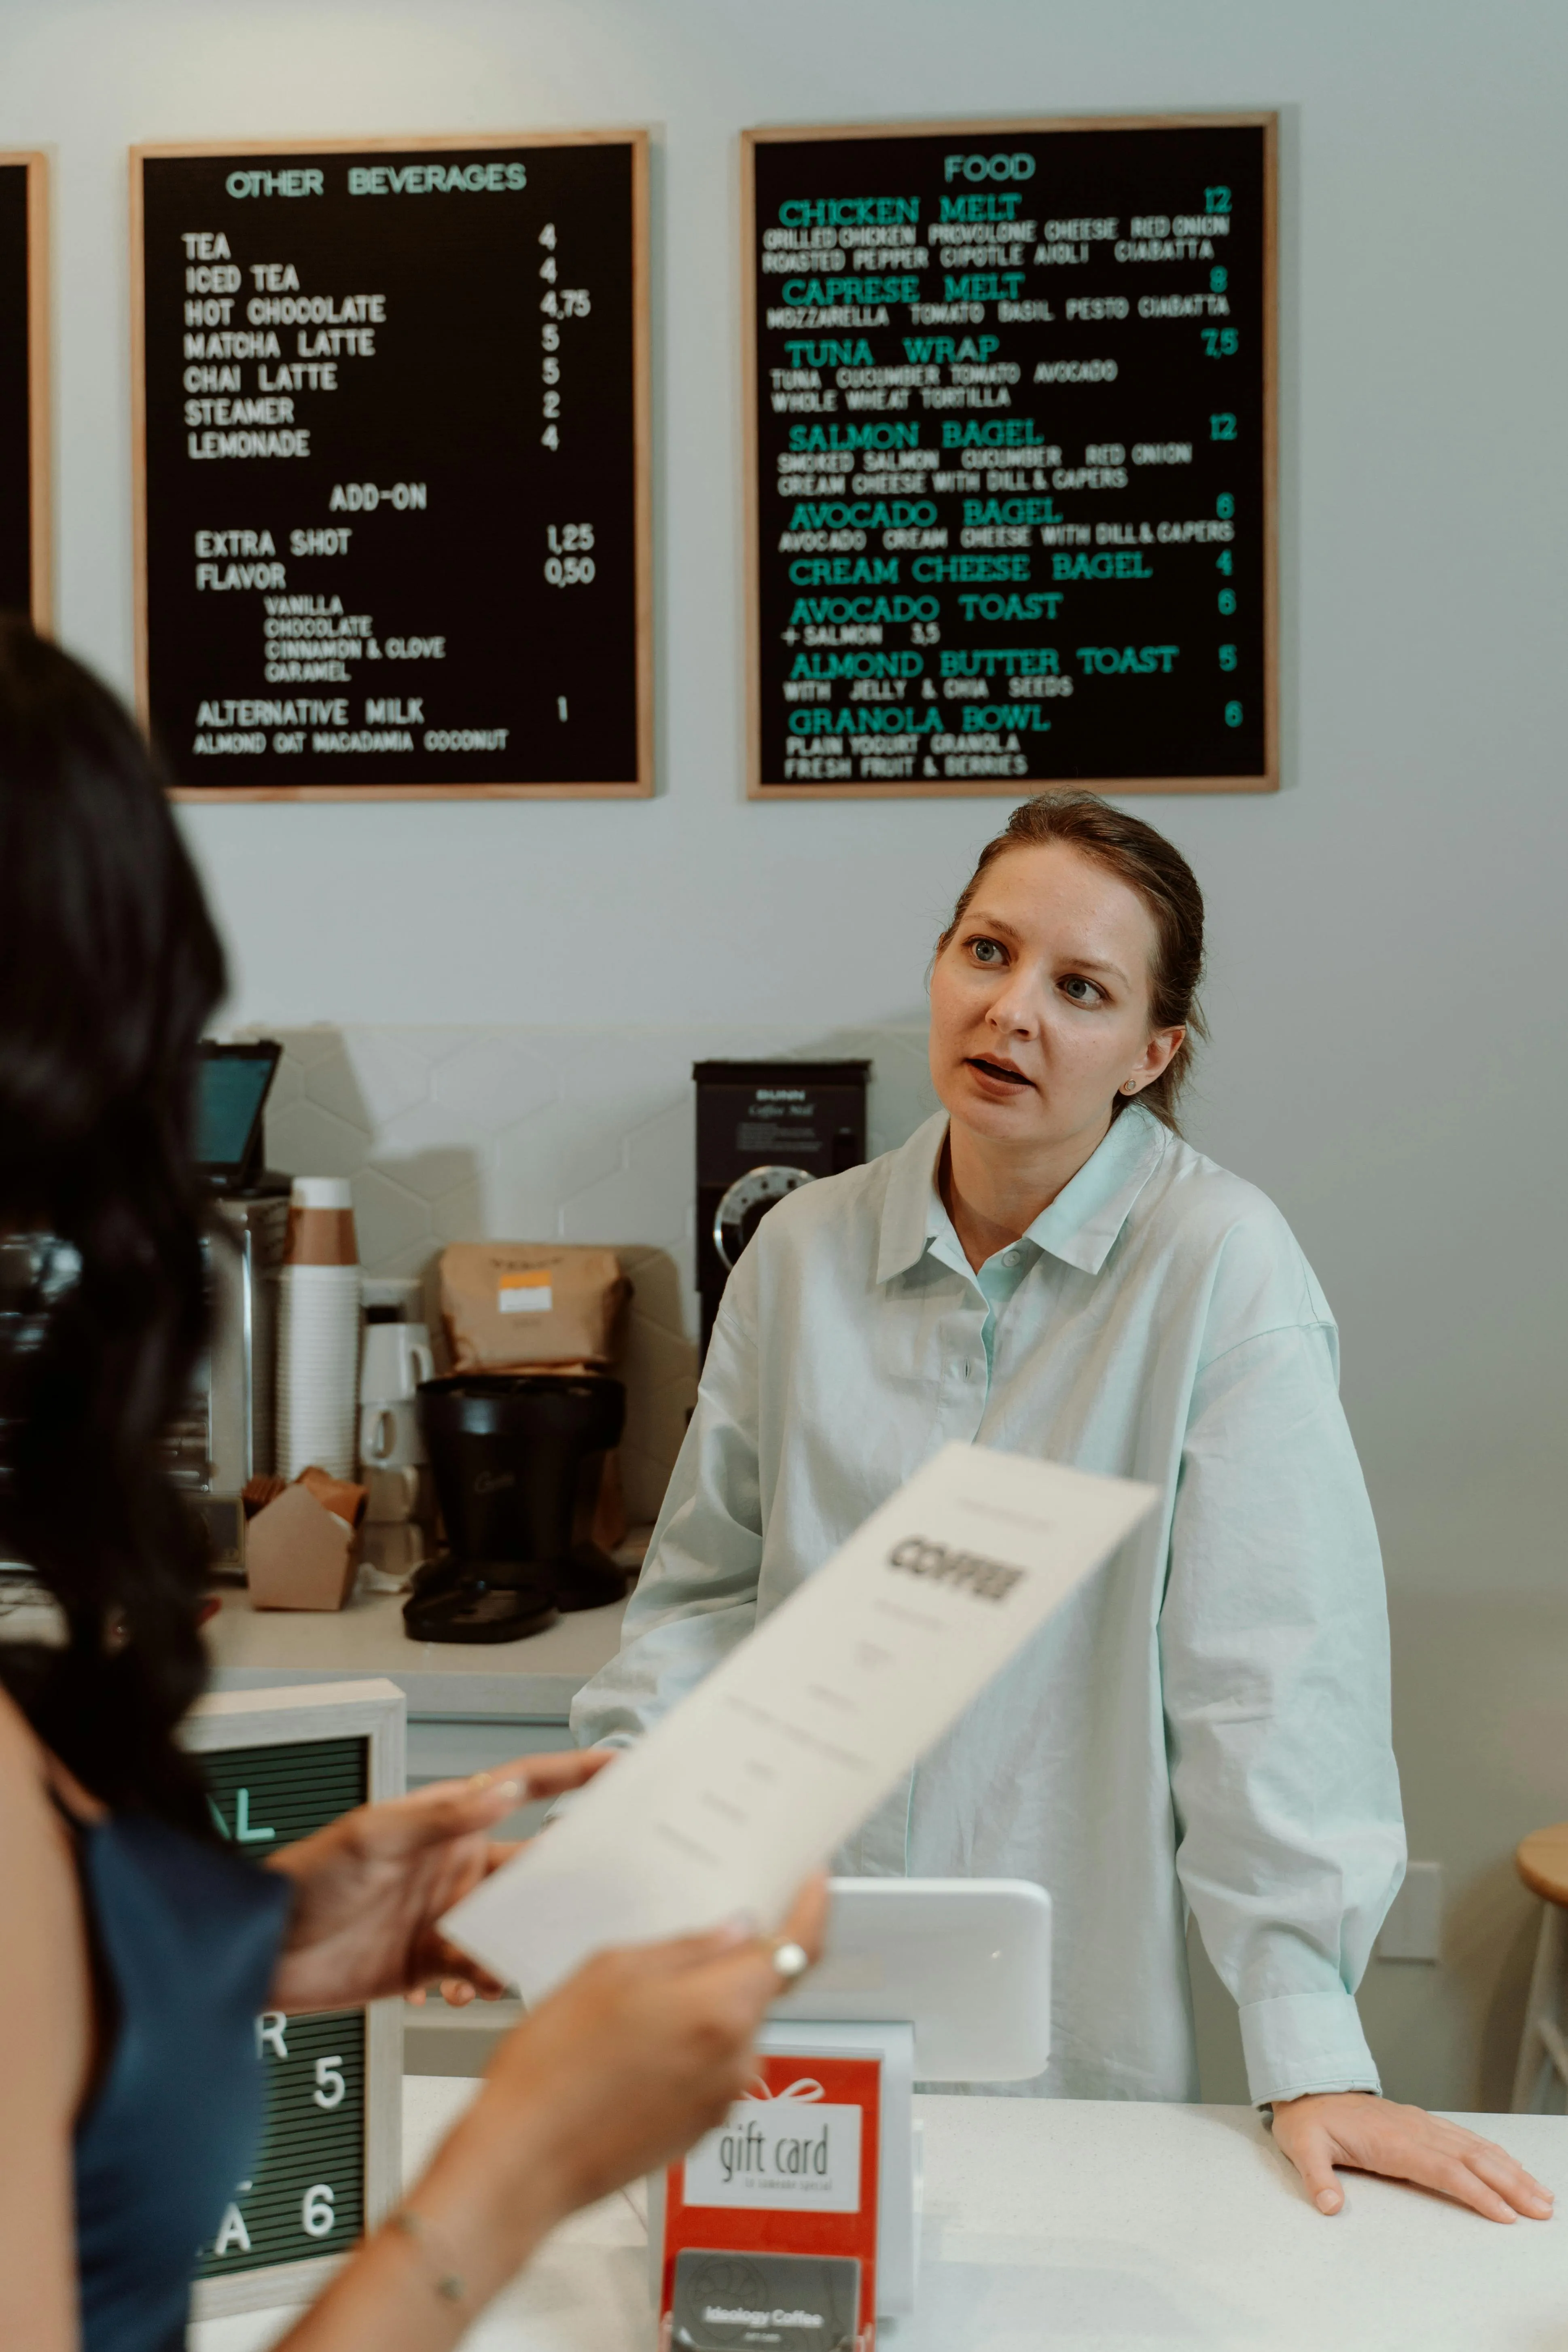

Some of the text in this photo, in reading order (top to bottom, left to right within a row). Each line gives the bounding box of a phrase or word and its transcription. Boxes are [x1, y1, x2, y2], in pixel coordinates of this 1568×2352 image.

[226, 163, 526, 199] OTHER BEVERAGES
[945, 153, 1036, 182] FOOD
[778, 187, 1232, 227] CHICKEN MELT 12
[182, 222, 557, 260] TEA 4
[763, 215, 1230, 250] GRILLED CHICKEN PROVOLONE CHEESE RED ONION
[763, 250, 845, 273] ROASTED
[854, 247, 928, 269] PEPPER
[1115, 239, 1214, 262] CIABATTA
[186, 256, 557, 293] ICED TEA 4
[782, 266, 1228, 305] CAPRESE MELT 8
[184, 299, 234, 326] HOT
[247, 295, 386, 324] CHOCOLATE
[767, 306, 889, 328] MOZZARELLA
[910, 303, 985, 325] TOMATO
[1066, 298, 1129, 320] PESTO
[1138, 295, 1229, 318] CIABATTA
[184, 324, 560, 359] MATCHA LATTE 5
[784, 339, 873, 367] TUNA
[903, 335, 999, 363] WRAP
[184, 357, 560, 392] CHAI LATTE 5
[770, 360, 1118, 391] TUNA CUCUMBER TOMATO AVOCADO
[184, 390, 561, 426] STEAMER 2
[770, 386, 1011, 413] WHOLE WHEAT TORTILLA
[188, 426, 560, 458] LEMONADE 4
[788, 414, 1237, 451] SALMON BAGEL 12
[777, 443, 1192, 474] SMOKED SALMON CUCUMBER RED ONION
[330, 483, 427, 511] ADD-ON
[778, 474, 845, 496] CREAM
[852, 473, 925, 494] CHEESE
[932, 471, 980, 493] WITH
[987, 470, 1030, 492] DILL
[1052, 468, 1128, 489] CAPERS
[790, 492, 1235, 530] AVOCADO BAGEL 6
[196, 530, 275, 557] EXTRA
[291, 528, 352, 556] SHOT
[779, 529, 866, 552] AVOCADO
[883, 528, 948, 549] CREAM
[961, 526, 1032, 548] CHEESE
[1039, 524, 1089, 545] WITH
[1095, 523, 1137, 545] DILL
[1156, 521, 1234, 543] CAPERS
[196, 562, 286, 589] FLAVOR
[788, 549, 1233, 585] CREAM CHEESE BAGEL 4
[264, 596, 343, 616] VANILLA
[790, 588, 1237, 625] AVOCADO TOAST 6
[264, 617, 373, 638] CHOCOLATE
[804, 624, 883, 646] SALMON
[265, 639, 362, 659] CINNAMON
[386, 637, 445, 658] CLOVE
[790, 645, 1238, 680] ALMOND BUTTER TOAST 5
[265, 661, 351, 682] CARAMEL
[782, 680, 831, 702] WITH
[848, 679, 907, 701] JELLY
[1009, 676, 1073, 698] SEEDS
[197, 695, 568, 727] ALTERNATIVE MILK 1
[788, 700, 1244, 735] GRANOLA BOWL 6
[193, 729, 509, 754] ALMOND OAT MACADAMIA COCONUT
[786, 735, 843, 756] PLAIN
[930, 732, 1020, 754] GRANOLA
[784, 756, 852, 779] FRESH
[860, 756, 917, 778] FRUIT
[313, 2055, 345, 2110] 5
[720, 2120, 828, 2182] gift card
[302, 2184, 335, 2237] 6
[772, 2309, 824, 2328] Coffee
